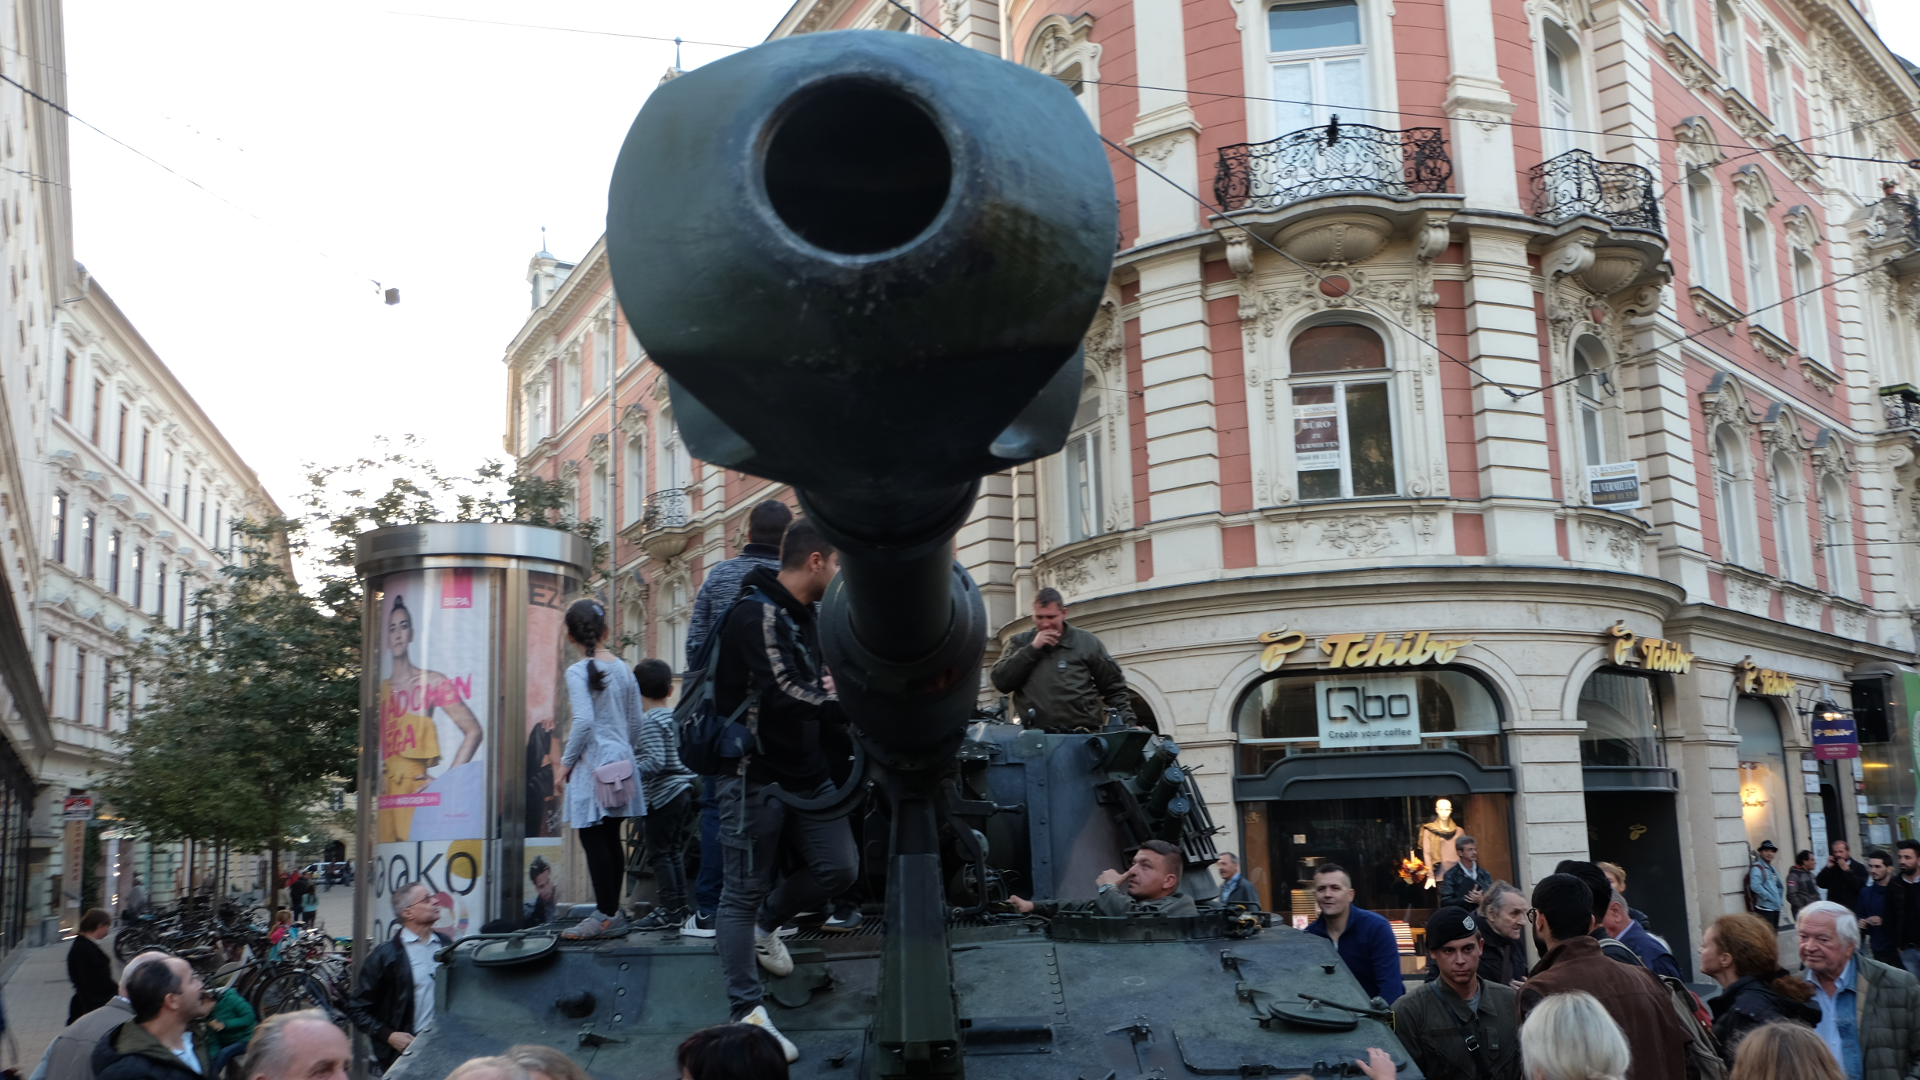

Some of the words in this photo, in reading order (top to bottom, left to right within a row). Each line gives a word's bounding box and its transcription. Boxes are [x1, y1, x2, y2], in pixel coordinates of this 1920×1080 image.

[1302, 420, 1331, 429] BÜRO
[443, 597, 470, 607] BIPA
[1320, 630, 1474, 669] Tchibo
[1640, 637, 1695, 675] Tchibo
[1759, 668, 1797, 698] Tchibo
[1326, 686, 1411, 724] Qbo
[1328, 730, 1359, 739] Create
[1361, 730, 1381, 739] your
[1384, 728, 1413, 737] coffee
